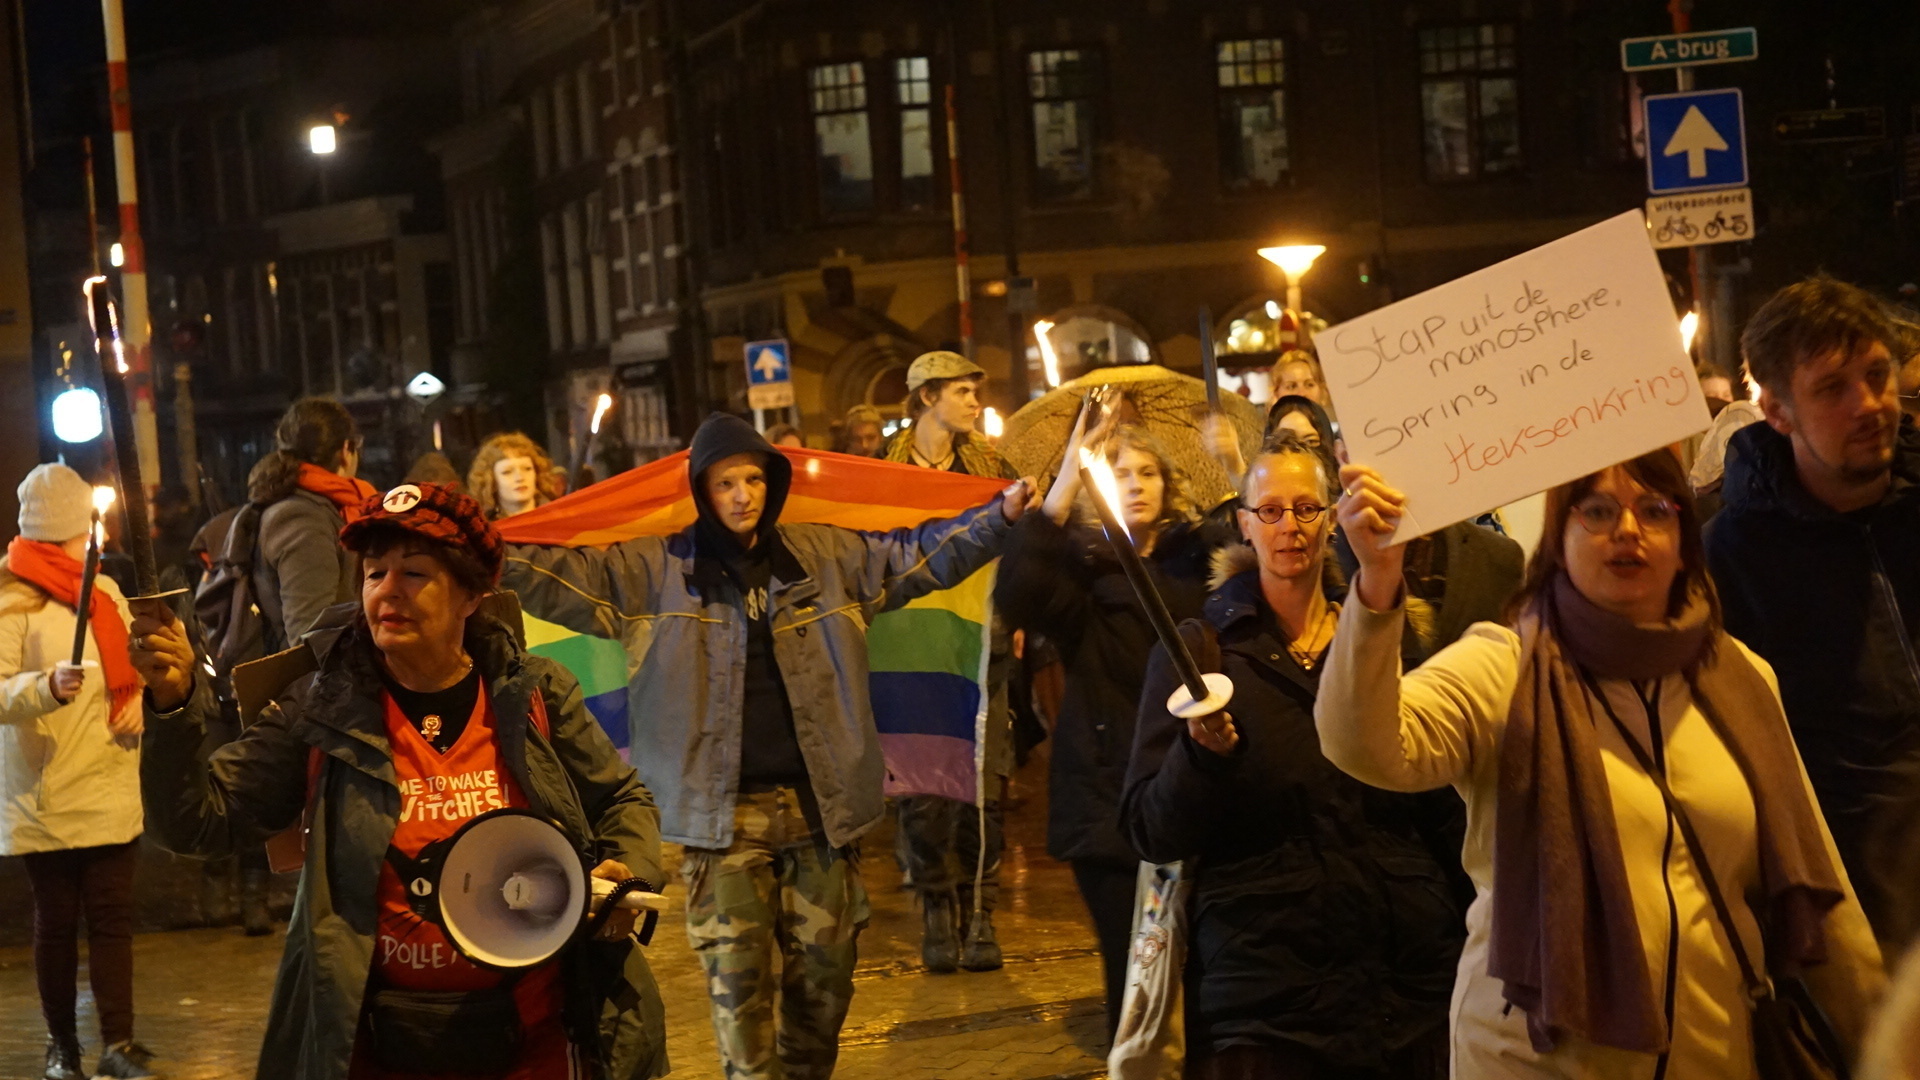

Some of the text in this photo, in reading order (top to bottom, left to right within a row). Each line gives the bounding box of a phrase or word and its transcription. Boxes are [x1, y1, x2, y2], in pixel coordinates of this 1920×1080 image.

[1651, 38, 1729, 61] A-brug
[1655, 193, 1745, 212] uitgezonderd
[1461, 294, 1505, 336] uit
[1514, 281, 1549, 315] de
[1363, 339, 1594, 456] Spring in de
[426, 775, 447, 793] TO
[448, 770, 499, 791] WAKE
